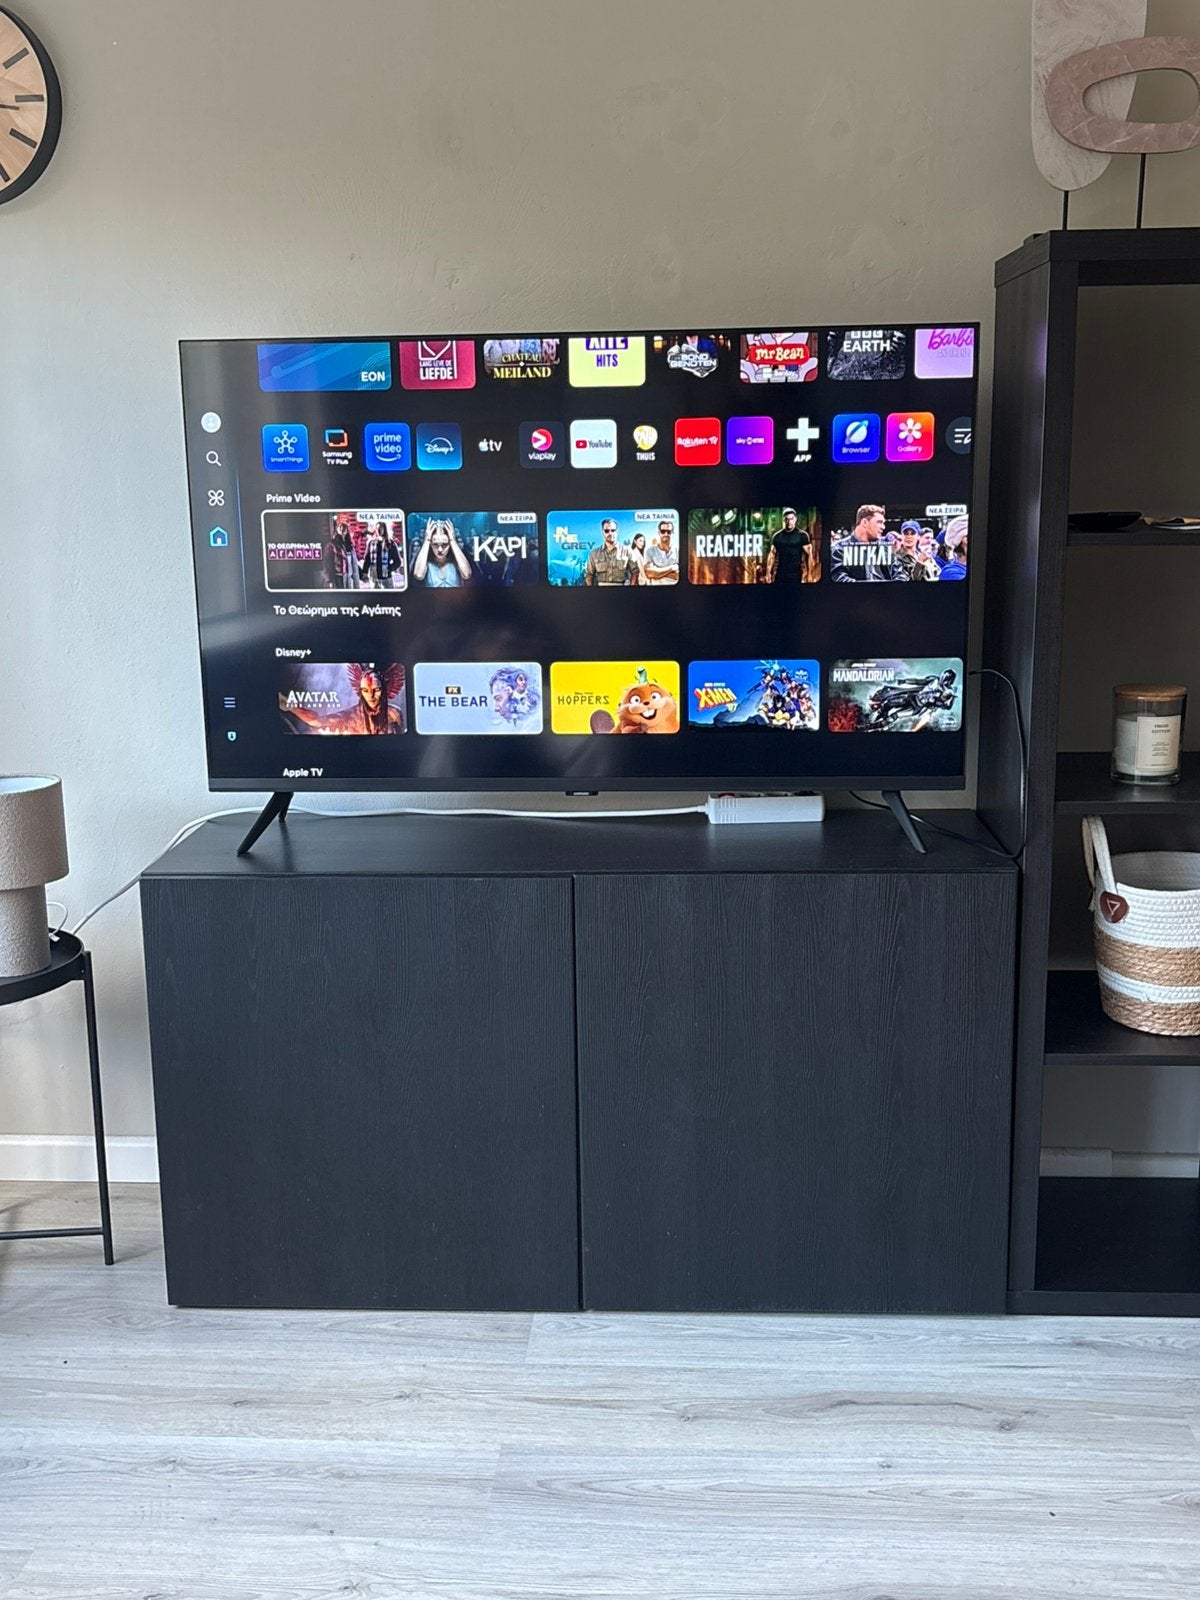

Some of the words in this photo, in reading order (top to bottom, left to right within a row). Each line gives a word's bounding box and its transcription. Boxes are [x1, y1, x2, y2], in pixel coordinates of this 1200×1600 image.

[843, 339, 891, 353] EARTH
[682, 353, 709, 361] BOND
[775, 346, 804, 361] Bean
[596, 353, 619, 367] HITS
[361, 371, 386, 382] EON
[420, 367, 453, 380] LIEFDE
[493, 366, 552, 379] MEILAND
[373, 433, 402, 444] prime
[374, 443, 402, 453] video
[588, 440, 613, 449] YouTube
[897, 445, 923, 454] Gallery
[322, 451, 353, 459] Samsung
[841, 446, 871, 454] Browser
[528, 451, 557, 461] viaplay
[636, 452, 656, 461] THUIS
[793, 454, 812, 463] APP
[266, 494, 292, 503] Prime
[293, 493, 321, 503] Video
[561, 541, 596, 551] GREY
[696, 532, 764, 558] REACHER
[273, 605, 286, 615] Το
[288, 604, 338, 618] Θεώρημα
[340, 606, 359, 618] της
[361, 604, 401, 618] Αγάπης
[275, 648, 312, 659] Disney+
[833, 669, 895, 682] MANDALORIAN
[286, 690, 340, 703] AVATAR
[419, 696, 446, 707] THE
[451, 695, 488, 707] BEAR
[557, 695, 610, 705] HOPPERS
[283, 768, 309, 778] Apple
[310, 768, 323, 777] TV
